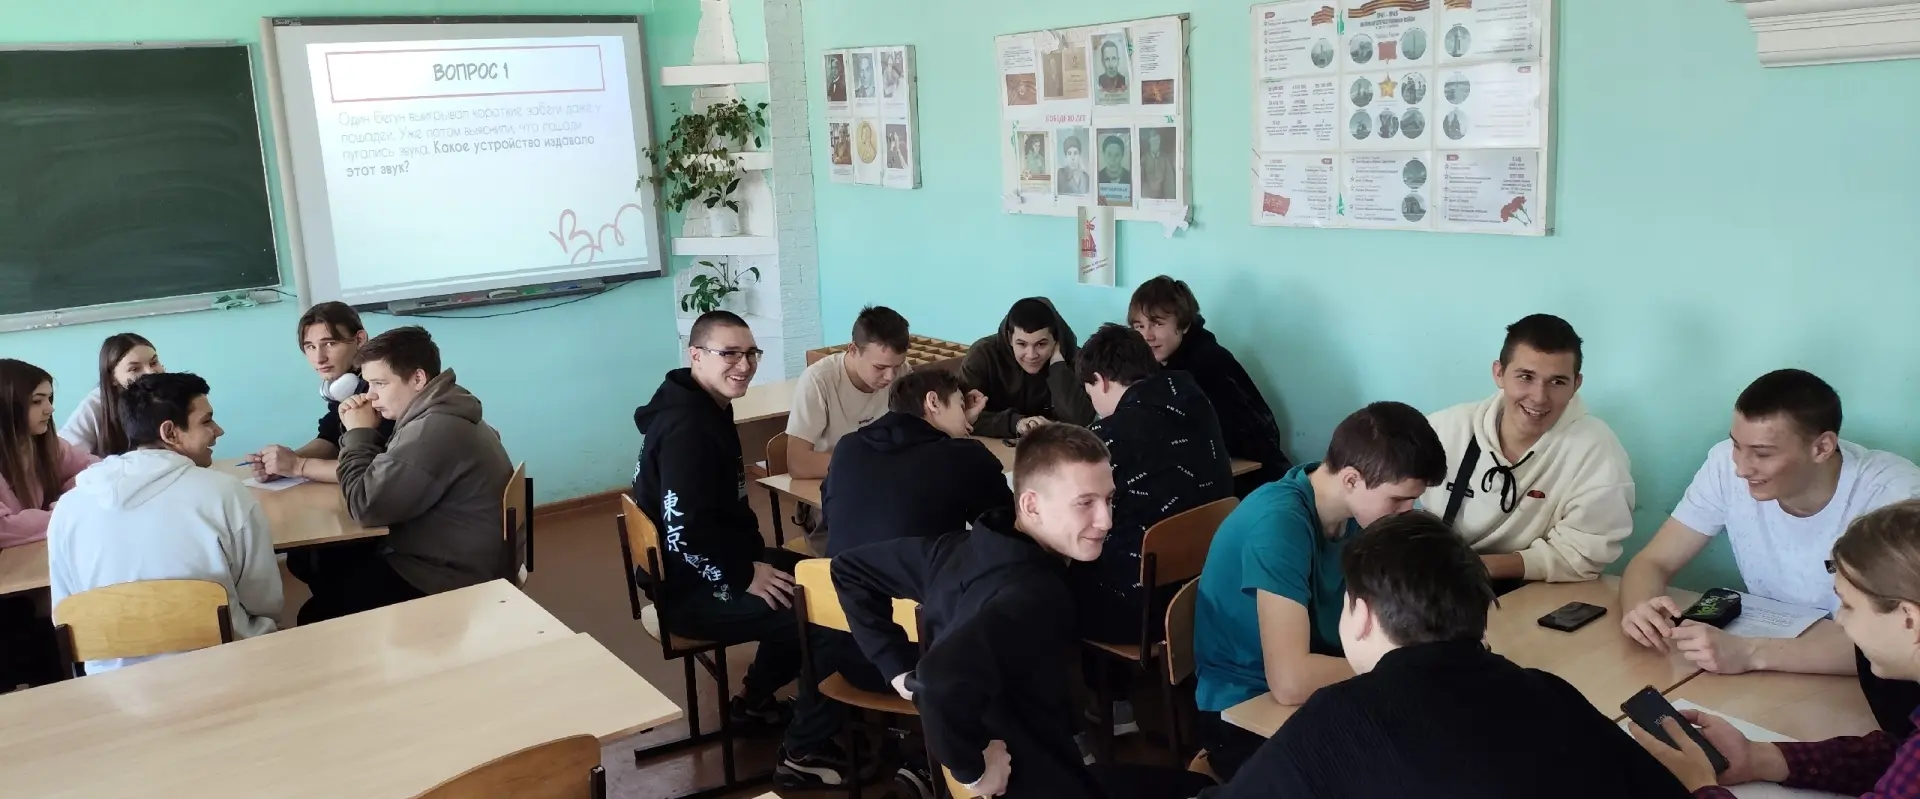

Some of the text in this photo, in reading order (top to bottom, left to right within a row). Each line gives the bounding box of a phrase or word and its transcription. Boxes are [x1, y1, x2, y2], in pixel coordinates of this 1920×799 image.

[432, 62, 509, 81] ВОПРОС 1
[338, 112, 370, 127] Один
[373, 110, 406, 124] бегун
[472, 107, 522, 120] короткие
[527, 102, 562, 116] забеги
[566, 103, 592, 116] даже
[400, 126, 422, 141] Уже
[426, 127, 461, 138] потом
[518, 123, 539, 133] что
[343, 135, 595, 162] пугались звука. Какое устройство издавало
[346, 160, 410, 177] этот звук?
[1127, 471, 1148, 485] PRADA
